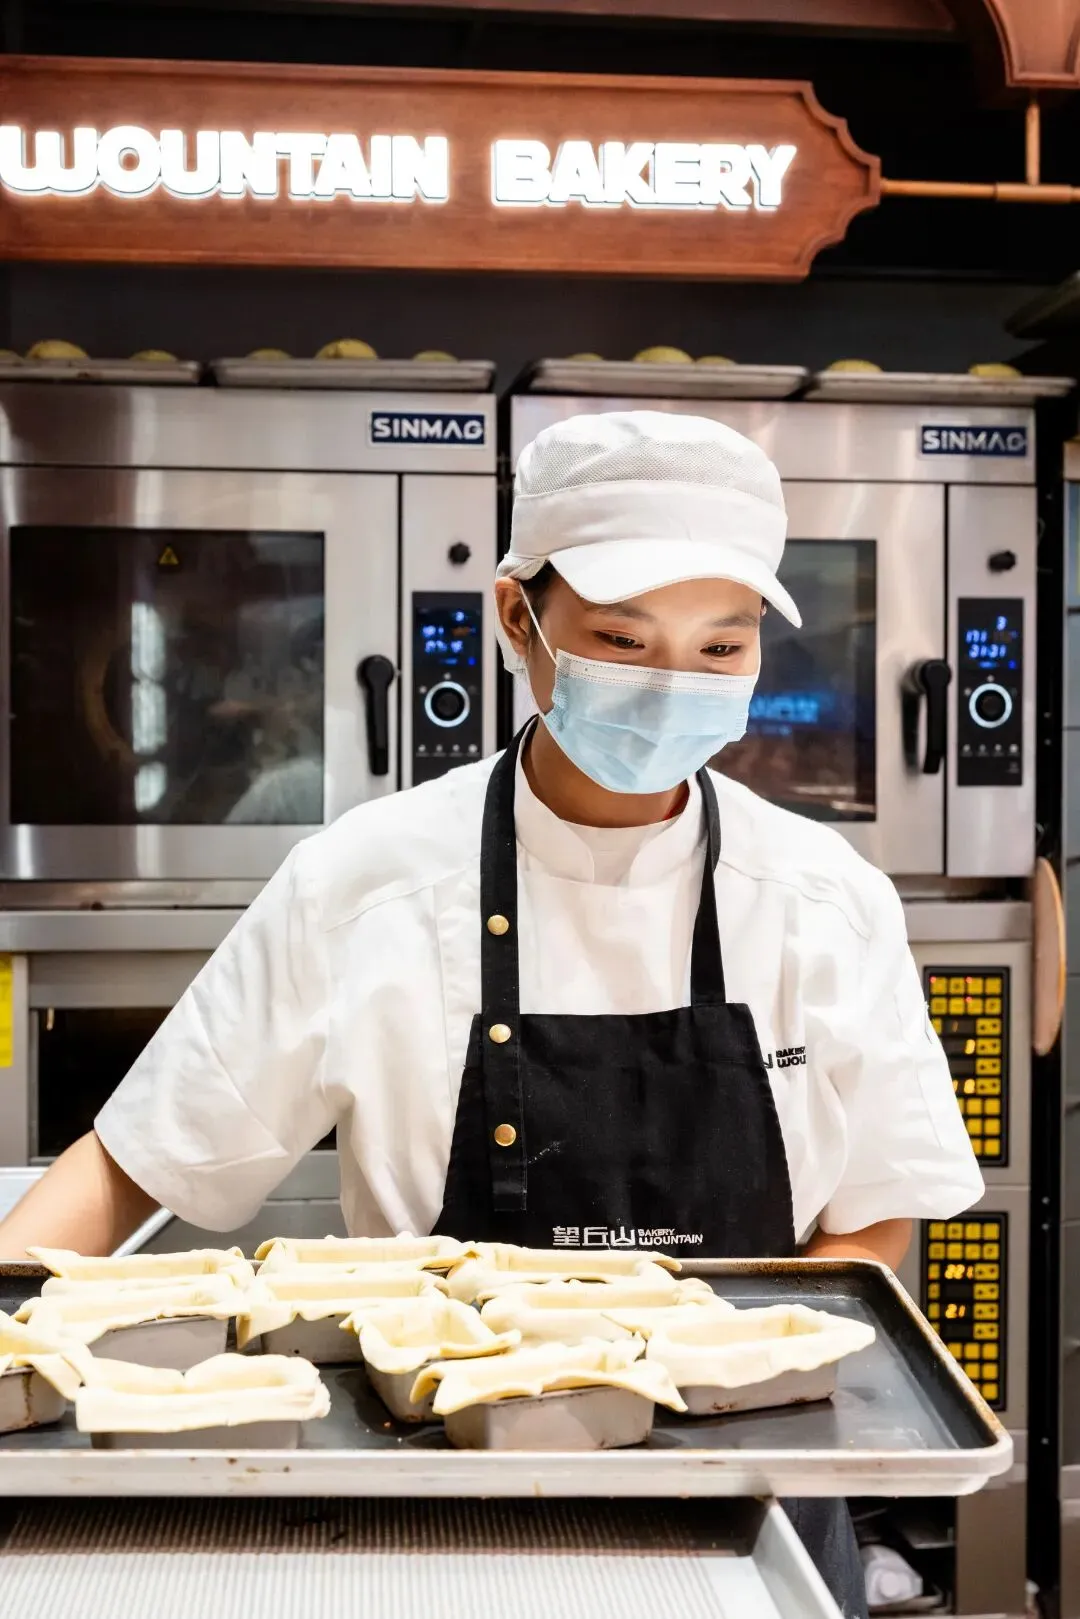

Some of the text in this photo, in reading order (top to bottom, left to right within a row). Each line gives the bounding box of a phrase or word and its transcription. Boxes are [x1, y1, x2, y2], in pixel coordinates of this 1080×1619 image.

[492, 138, 798, 211] BAKERY
[373, 417, 483, 440] SINMAG
[923, 430, 1026, 451] SINMAG
[638, 1229, 675, 1237] BAKERY
